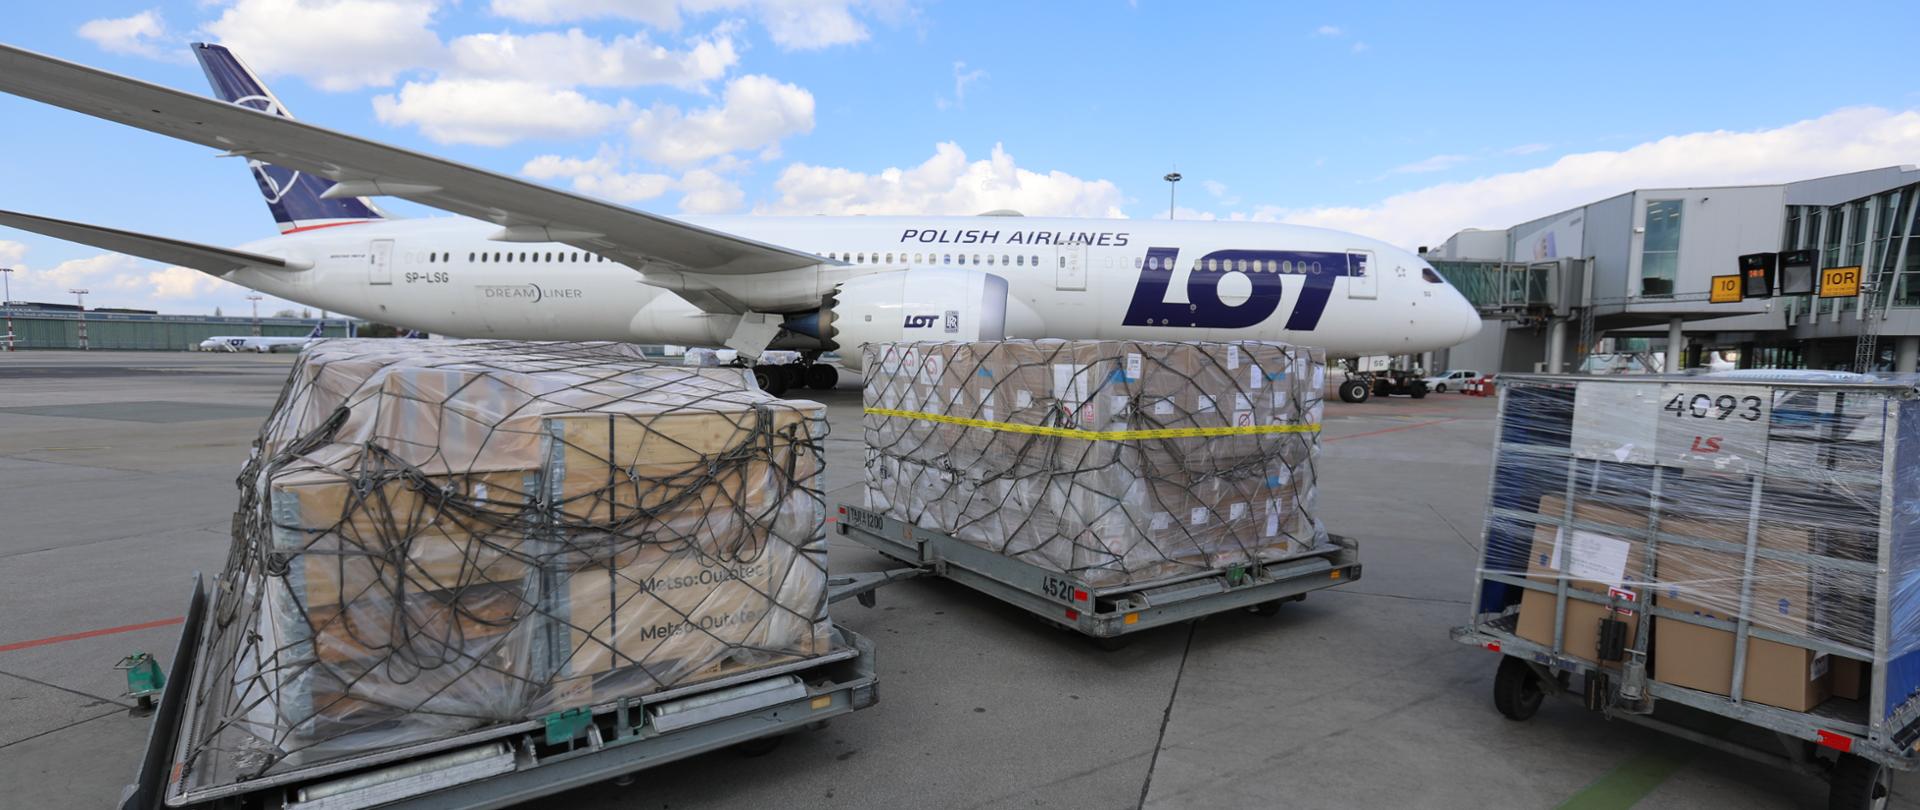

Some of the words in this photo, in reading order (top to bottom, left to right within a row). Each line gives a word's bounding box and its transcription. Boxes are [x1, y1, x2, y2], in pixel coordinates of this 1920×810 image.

[899, 229, 1000, 244] POLISH
[1006, 231, 1130, 247] AIRLINES
[405, 271, 449, 283] SP-LSG
[1826, 272, 1855, 285] 10R
[1122, 246, 1368, 332] LOT
[1721, 280, 1735, 291] 10
[903, 315, 939, 328] LOT
[1663, 392, 1762, 421] 4093
[867, 513, 883, 529] 1200
[1042, 575, 1074, 603] 4520
